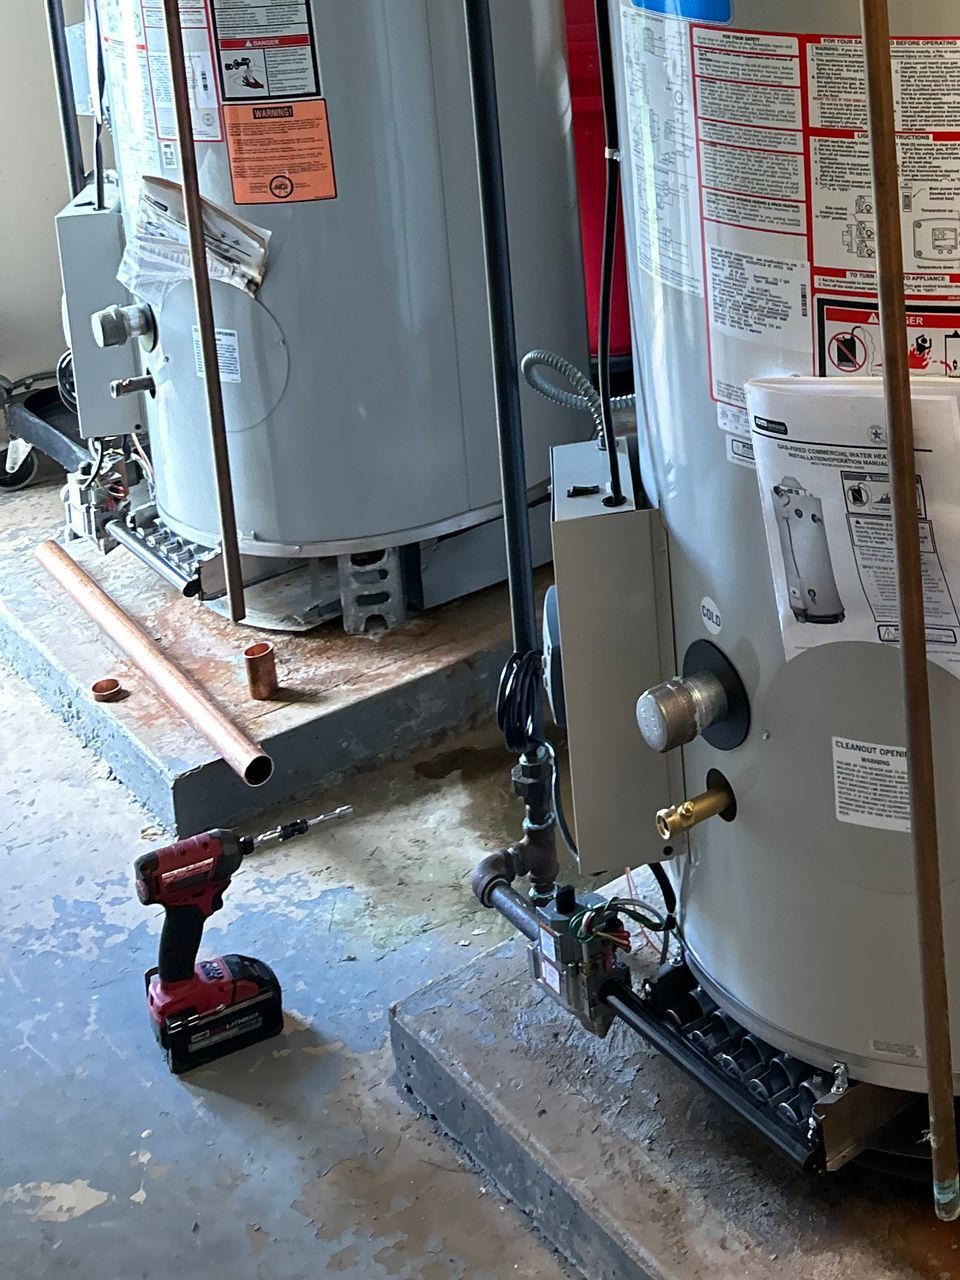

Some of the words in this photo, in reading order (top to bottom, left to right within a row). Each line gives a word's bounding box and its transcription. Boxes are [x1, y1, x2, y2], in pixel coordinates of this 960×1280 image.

[254, 108, 292, 118] WARNING!
[849, 452, 872, 460] WATER
[702, 605, 721, 627] COLD
[835, 741, 877, 754] CLEANOUT
[879, 749, 907, 758] OPENI
